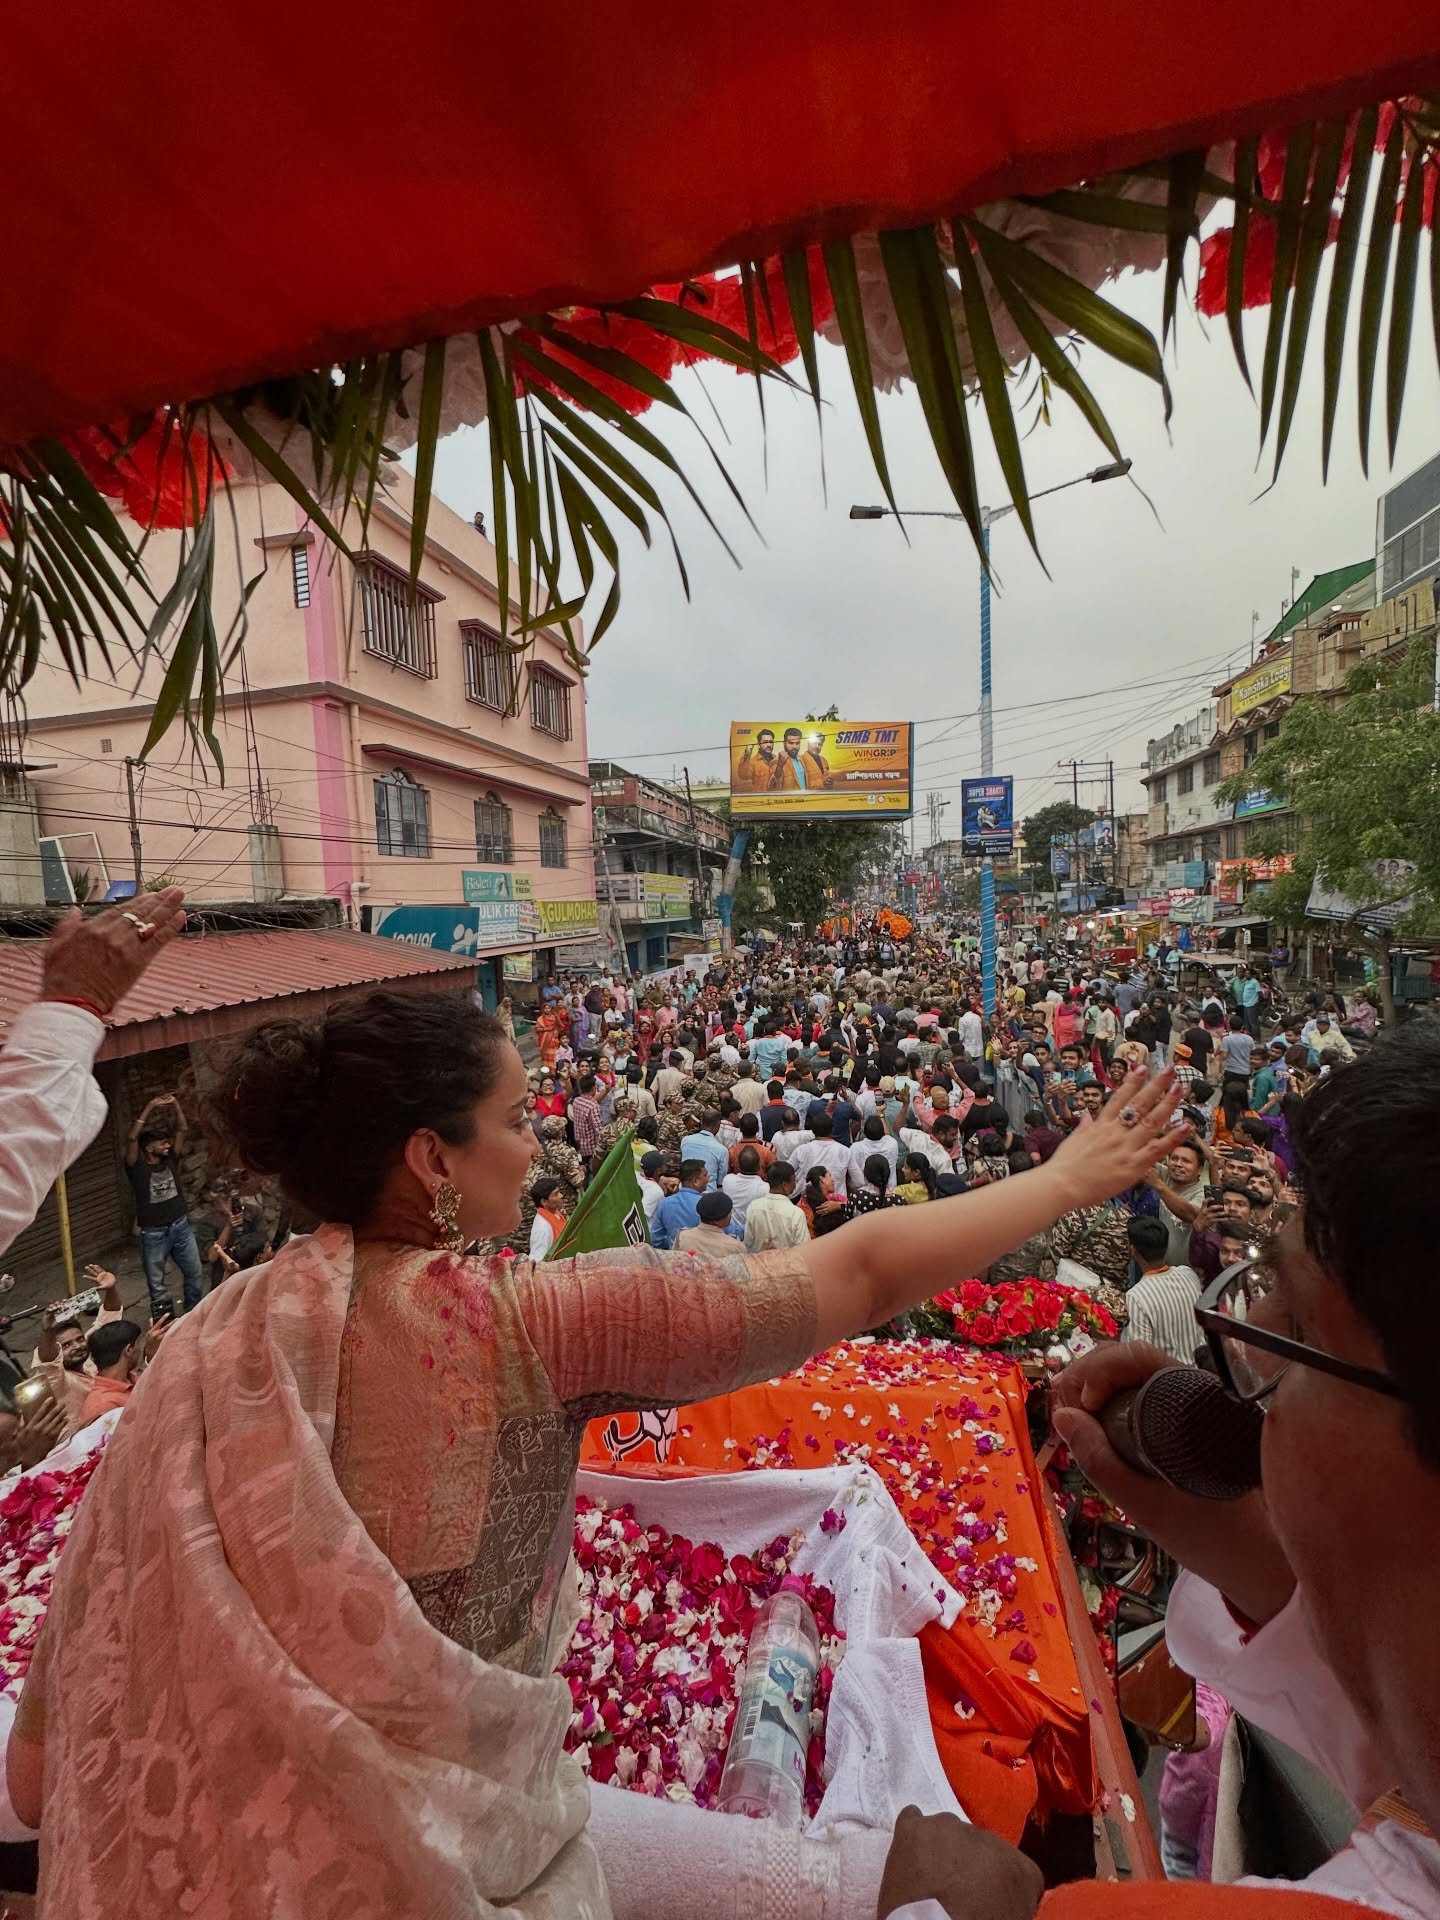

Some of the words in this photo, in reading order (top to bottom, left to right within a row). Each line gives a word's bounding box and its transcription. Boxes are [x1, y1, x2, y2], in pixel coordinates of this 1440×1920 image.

[875, 730, 900, 744] TMT
[466, 876, 492, 889] Bisleri
[479, 904, 502, 919] ULIK
[547, 902, 597, 922] GULMOHAR
